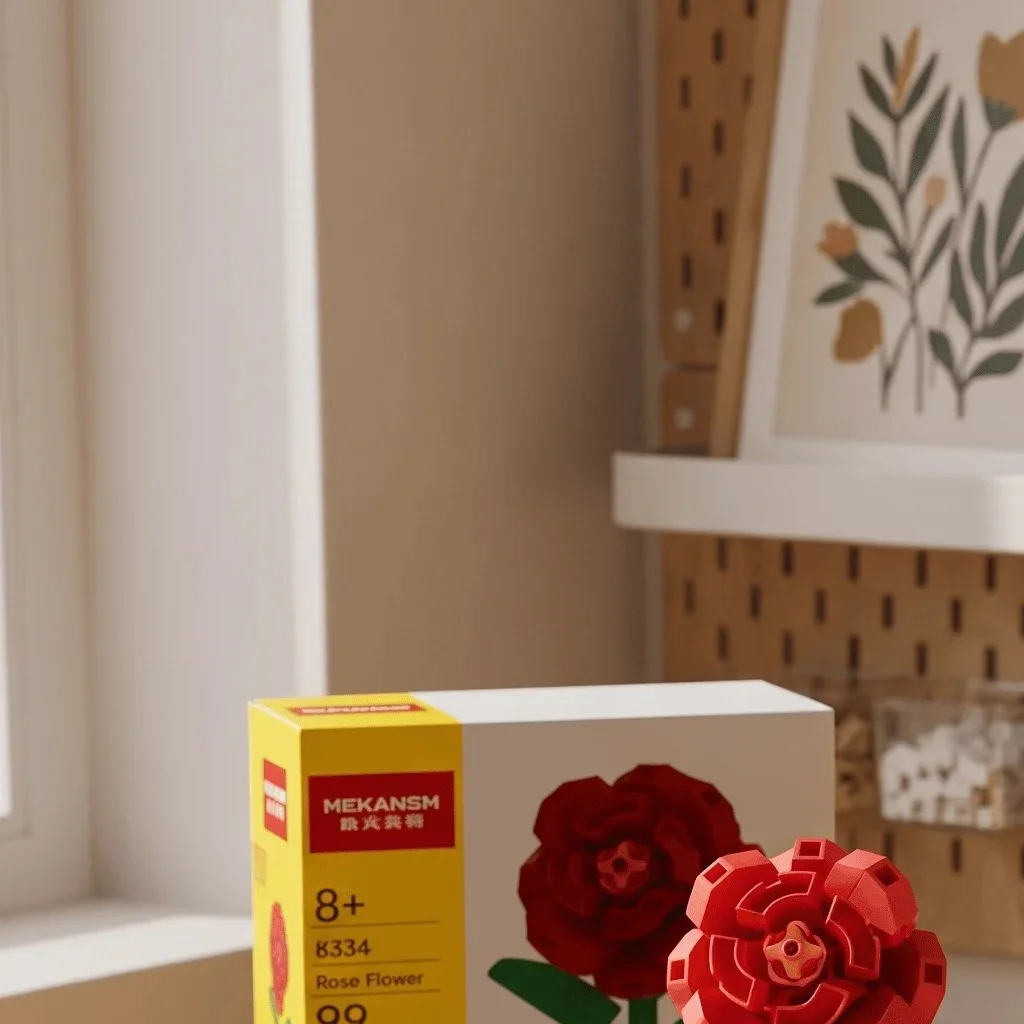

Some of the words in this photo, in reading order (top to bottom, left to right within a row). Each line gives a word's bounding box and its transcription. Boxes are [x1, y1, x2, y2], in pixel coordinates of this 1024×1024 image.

[323, 795, 440, 814] MEKANSM
[315, 888, 365, 923] 8+
[316, 974, 360, 990] Rose
[366, 972, 425, 988] Flower
